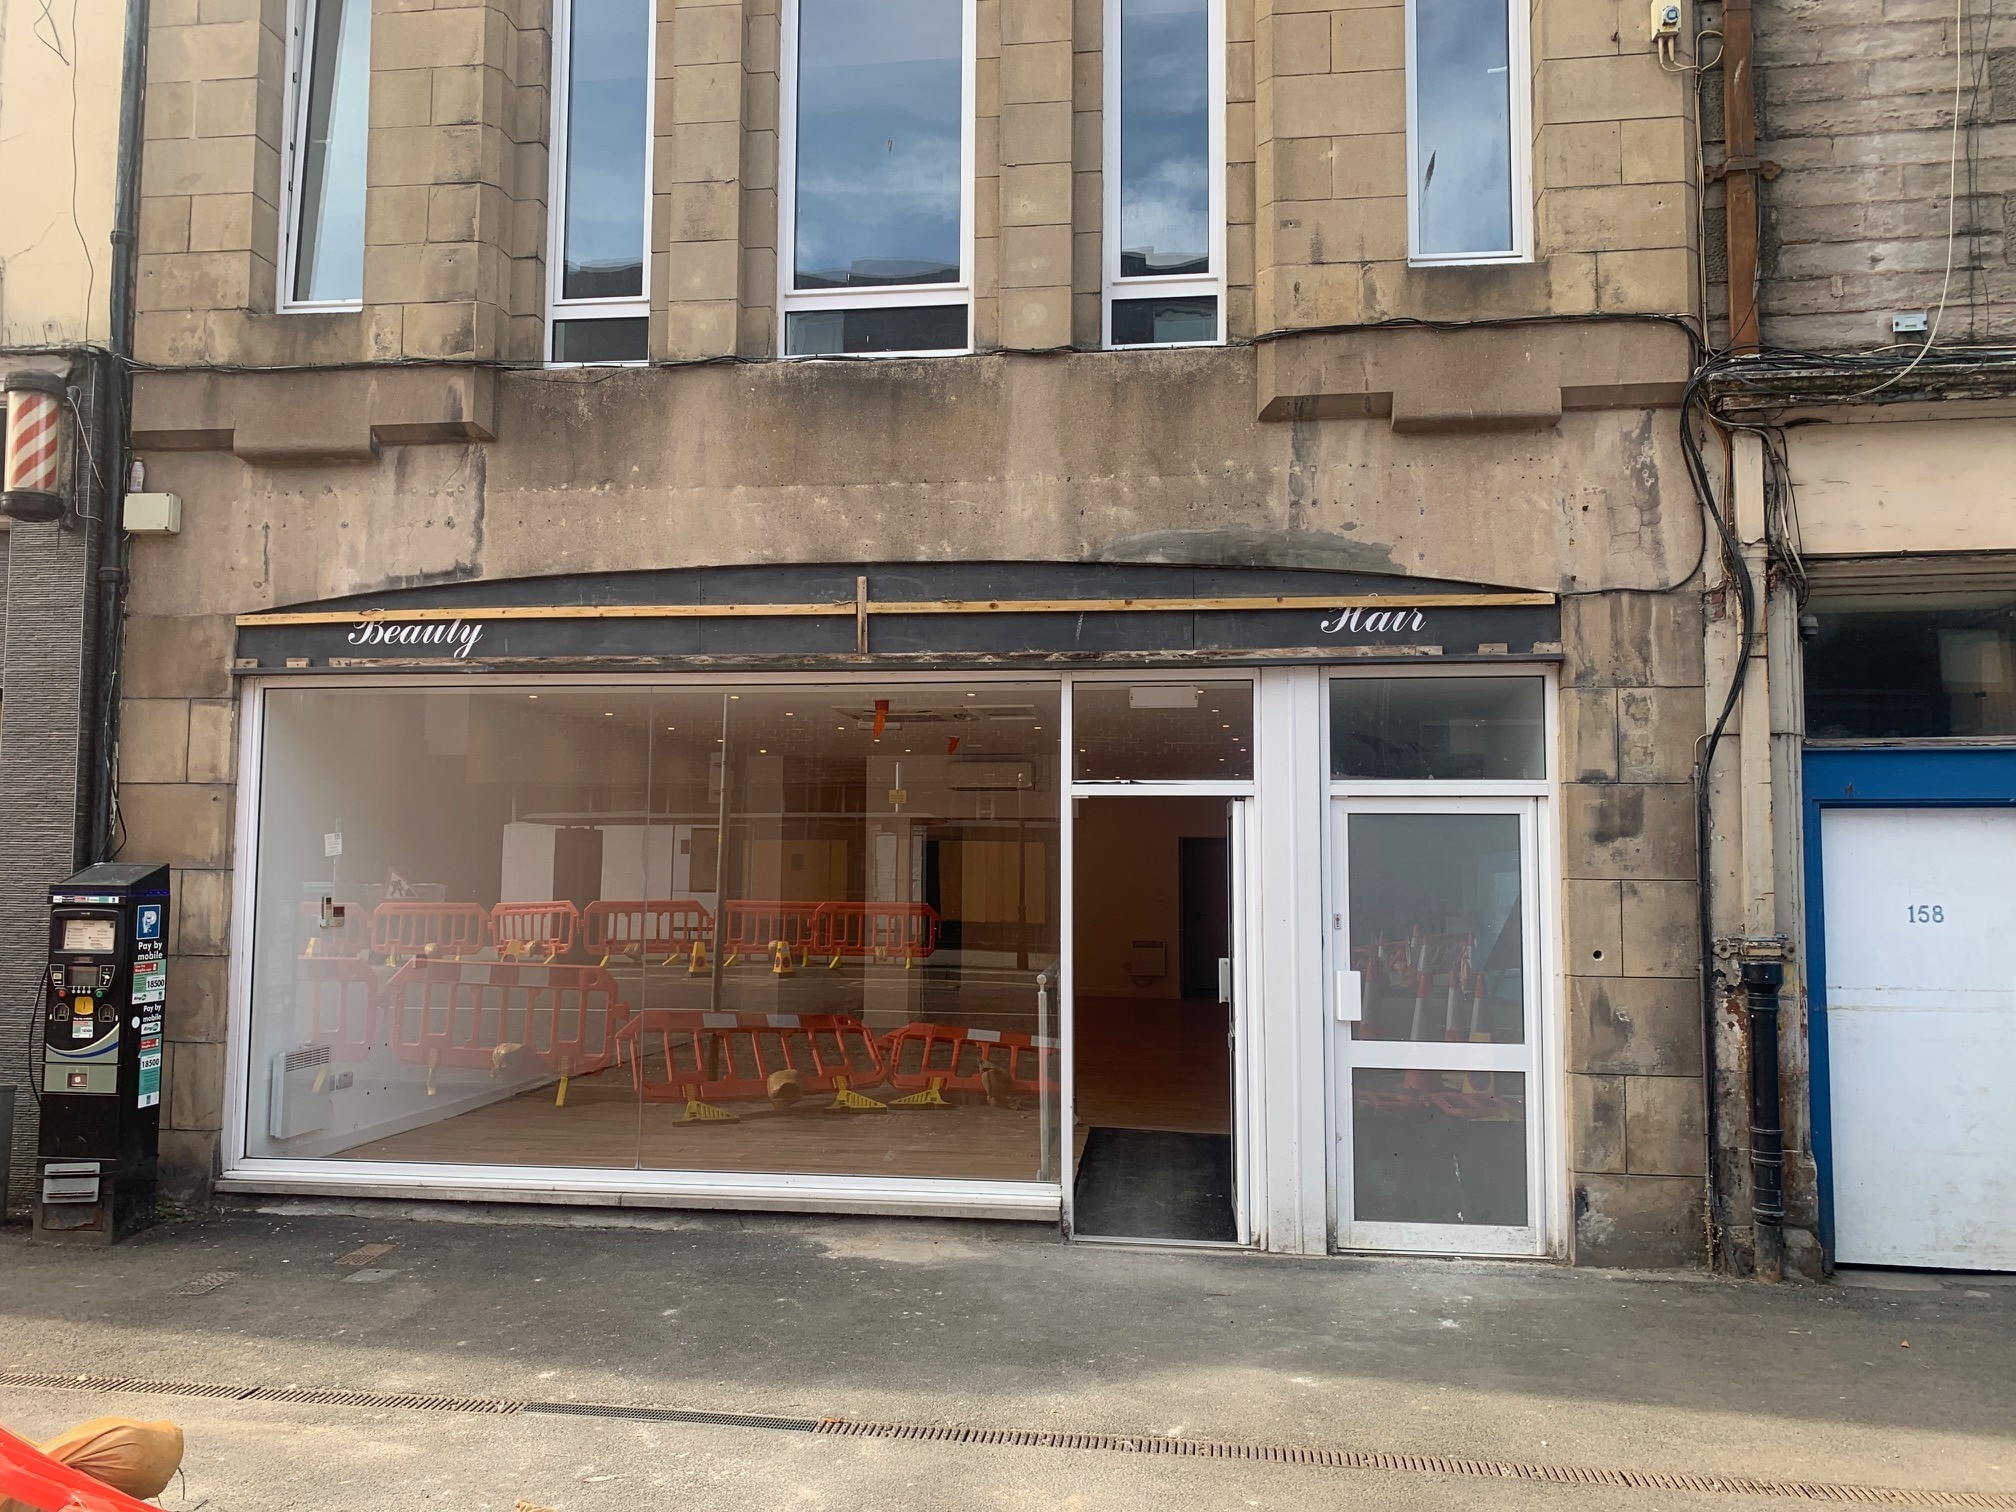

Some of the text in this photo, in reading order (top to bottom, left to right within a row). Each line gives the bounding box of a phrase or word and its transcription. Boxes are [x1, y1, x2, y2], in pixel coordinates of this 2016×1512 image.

[1908, 904, 1944, 923] 158
[138, 941, 163, 951] Pay by
[137, 951, 163, 961] mobile
[147, 980, 165, 988] 18500
[143, 1004, 162, 1013] Pay by
[143, 1013, 162, 1022] mobile
[142, 1058, 160, 1068] 18500
